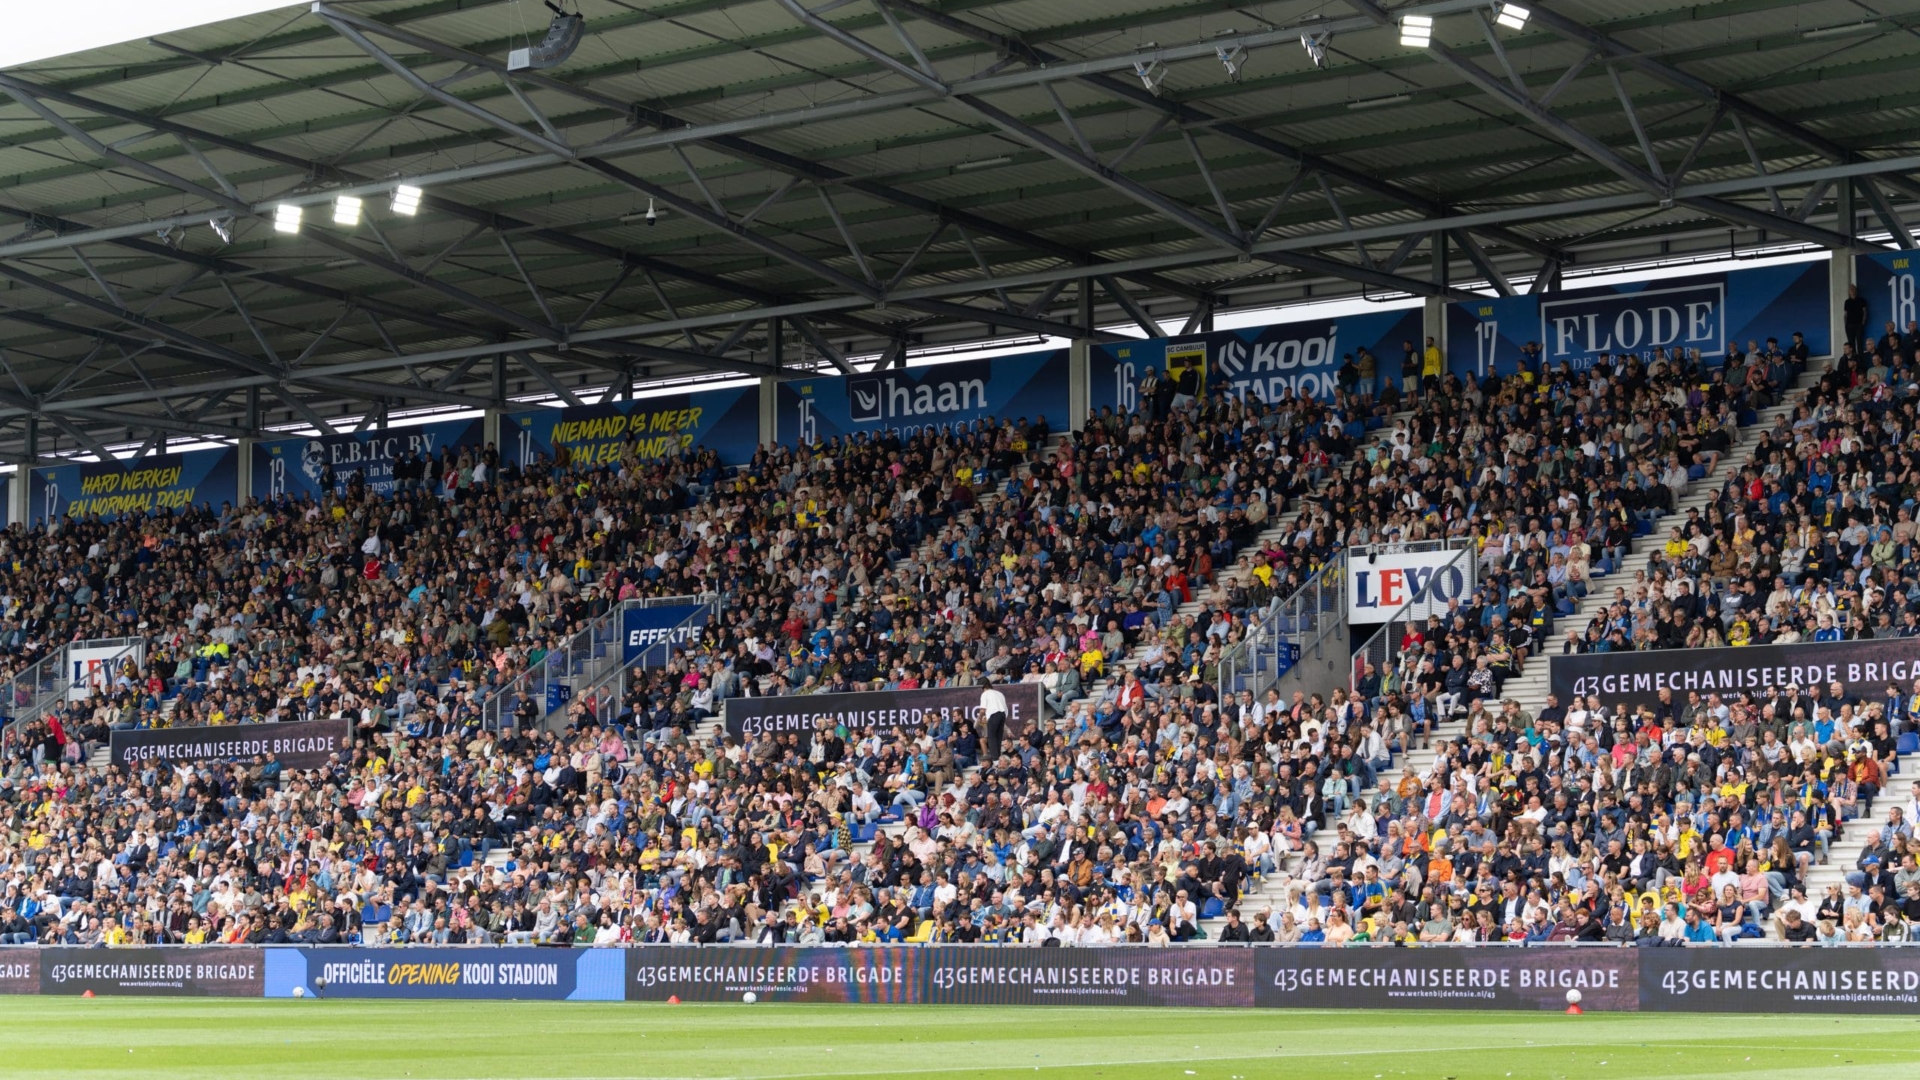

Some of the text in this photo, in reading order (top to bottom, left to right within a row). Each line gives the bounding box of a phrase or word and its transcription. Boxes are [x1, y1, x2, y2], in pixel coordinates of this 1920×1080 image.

[1892, 258, 1910, 270] VAK
[1479, 306, 1493, 317] VAK
[1888, 274, 1916, 334] 18
[1552, 301, 1713, 357] FLODE
[1117, 348, 1131, 358] VAK
[1474, 321, 1498, 377] 17
[801, 385, 813, 395] VAK
[885, 378, 988, 418] haan
[1114, 361, 1136, 415] 16
[1222, 370, 1340, 410] STADION
[522, 418, 532, 426] VAK
[550, 407, 704, 444] NIEMAND IS MEER
[798, 398, 816, 448] 15
[636, 433, 694, 461] ANDR
[81, 465, 182, 496] HARD WERKEN
[270, 458, 285, 502] 13
[370, 463, 381, 477] in
[44, 483, 59, 526] 12
[68, 487, 196, 518] EN NORMAAL DOEN
[1355, 565, 1464, 609] LEVO
[629, 626, 705, 647] EFFEKTIE
[274, 737, 334, 753] BRIGADE
[197, 965, 255, 980] BRIGADE
[324, 959, 558, 986] OFFICIËLE OPENING KOOI STADION
[826, 967, 903, 984] BRIGADE
[1148, 968, 1235, 986] BRIGADE
[1520, 969, 1620, 988] BRIGADE
[1388, 990, 1496, 999] www.werkenbijdefensie.nl/43
[1793, 993, 1919, 1003] www.werkenbijdefensie.nl/43
